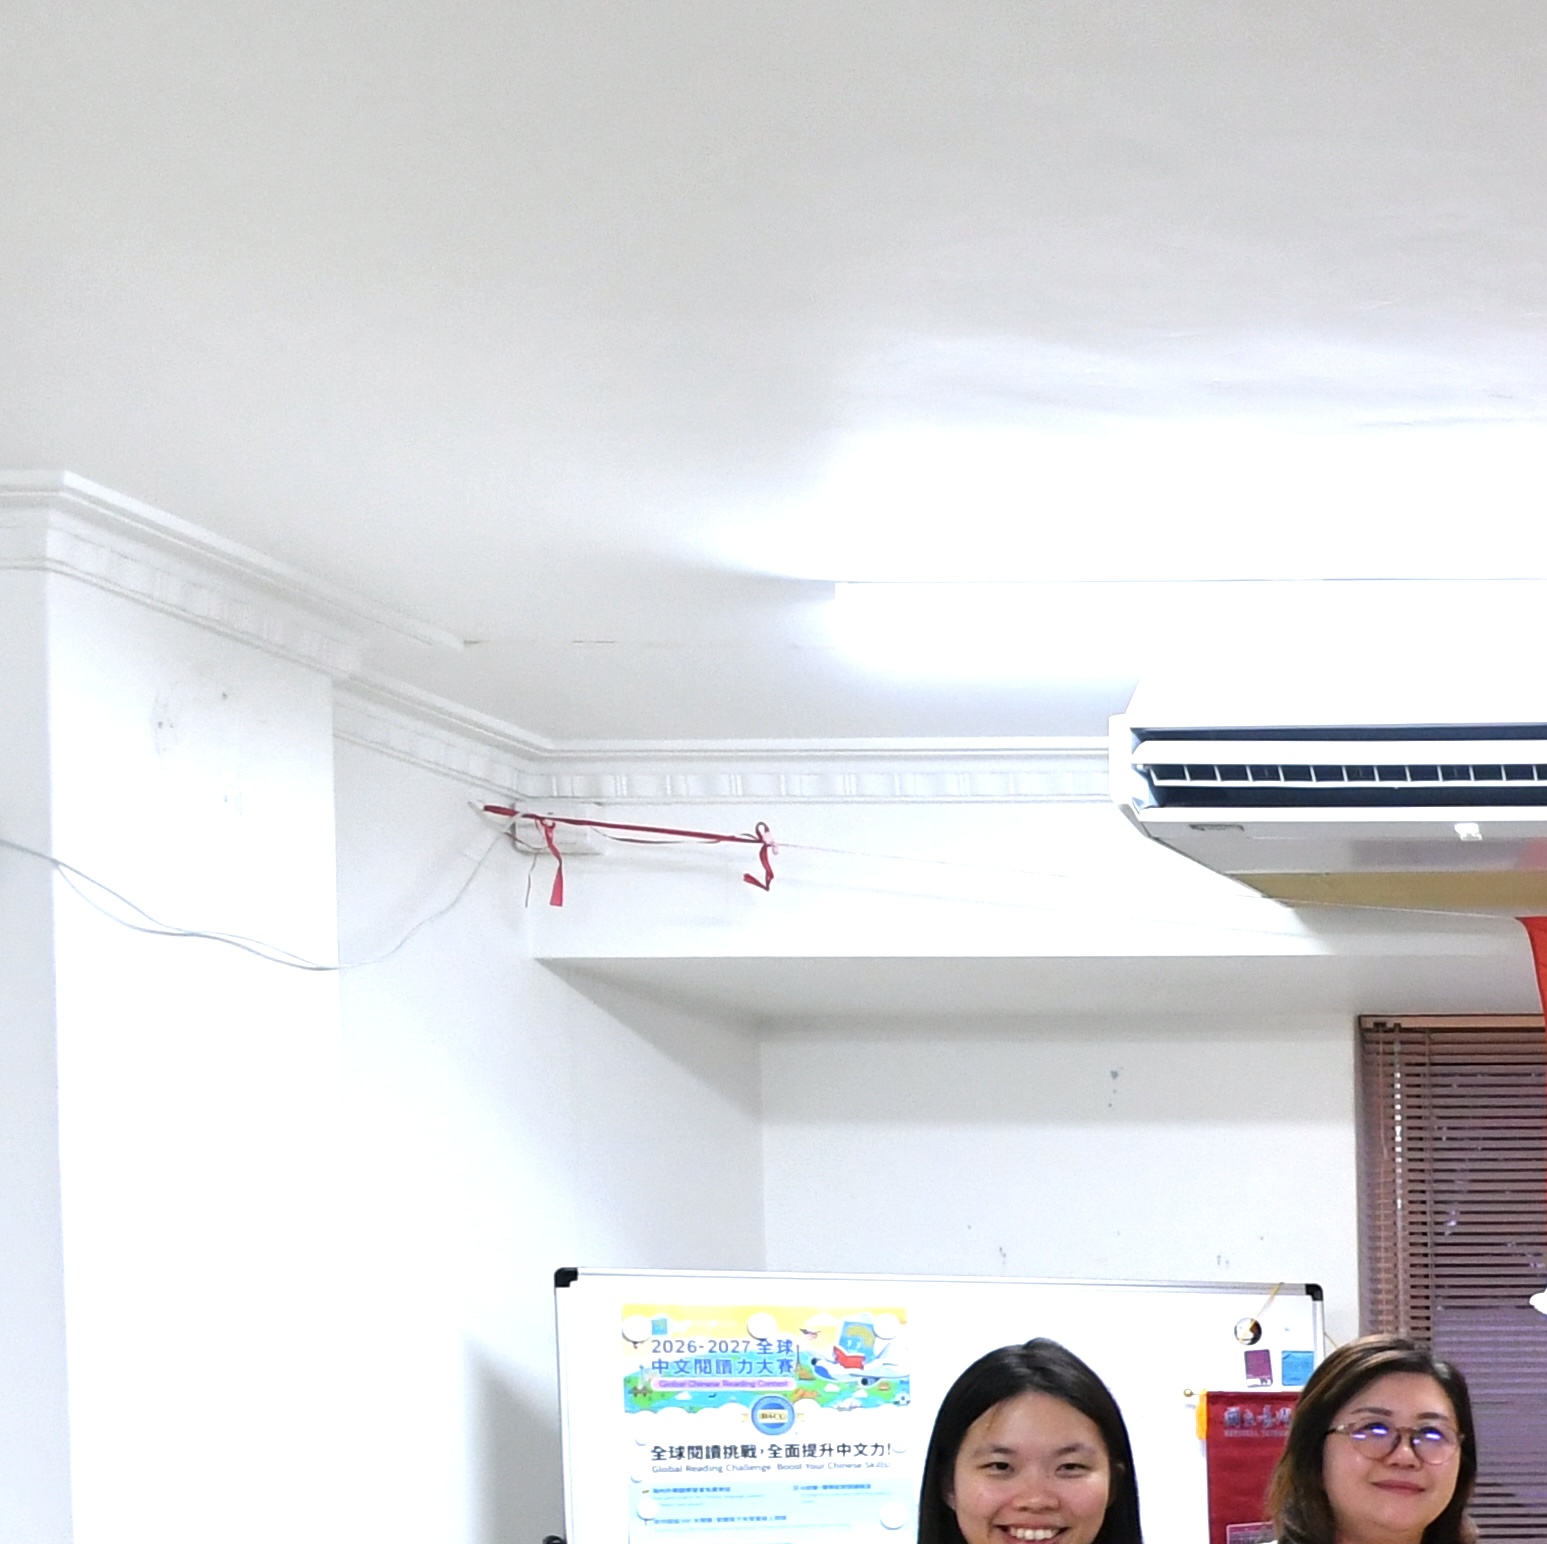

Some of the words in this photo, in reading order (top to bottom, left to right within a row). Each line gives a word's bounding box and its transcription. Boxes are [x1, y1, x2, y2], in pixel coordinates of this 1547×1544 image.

[652, 1339, 751, 1354] 2026-2027
[756, 1339, 794, 1355] 全球
[651, 1358, 794, 1375] 中文閱讀力大賽
